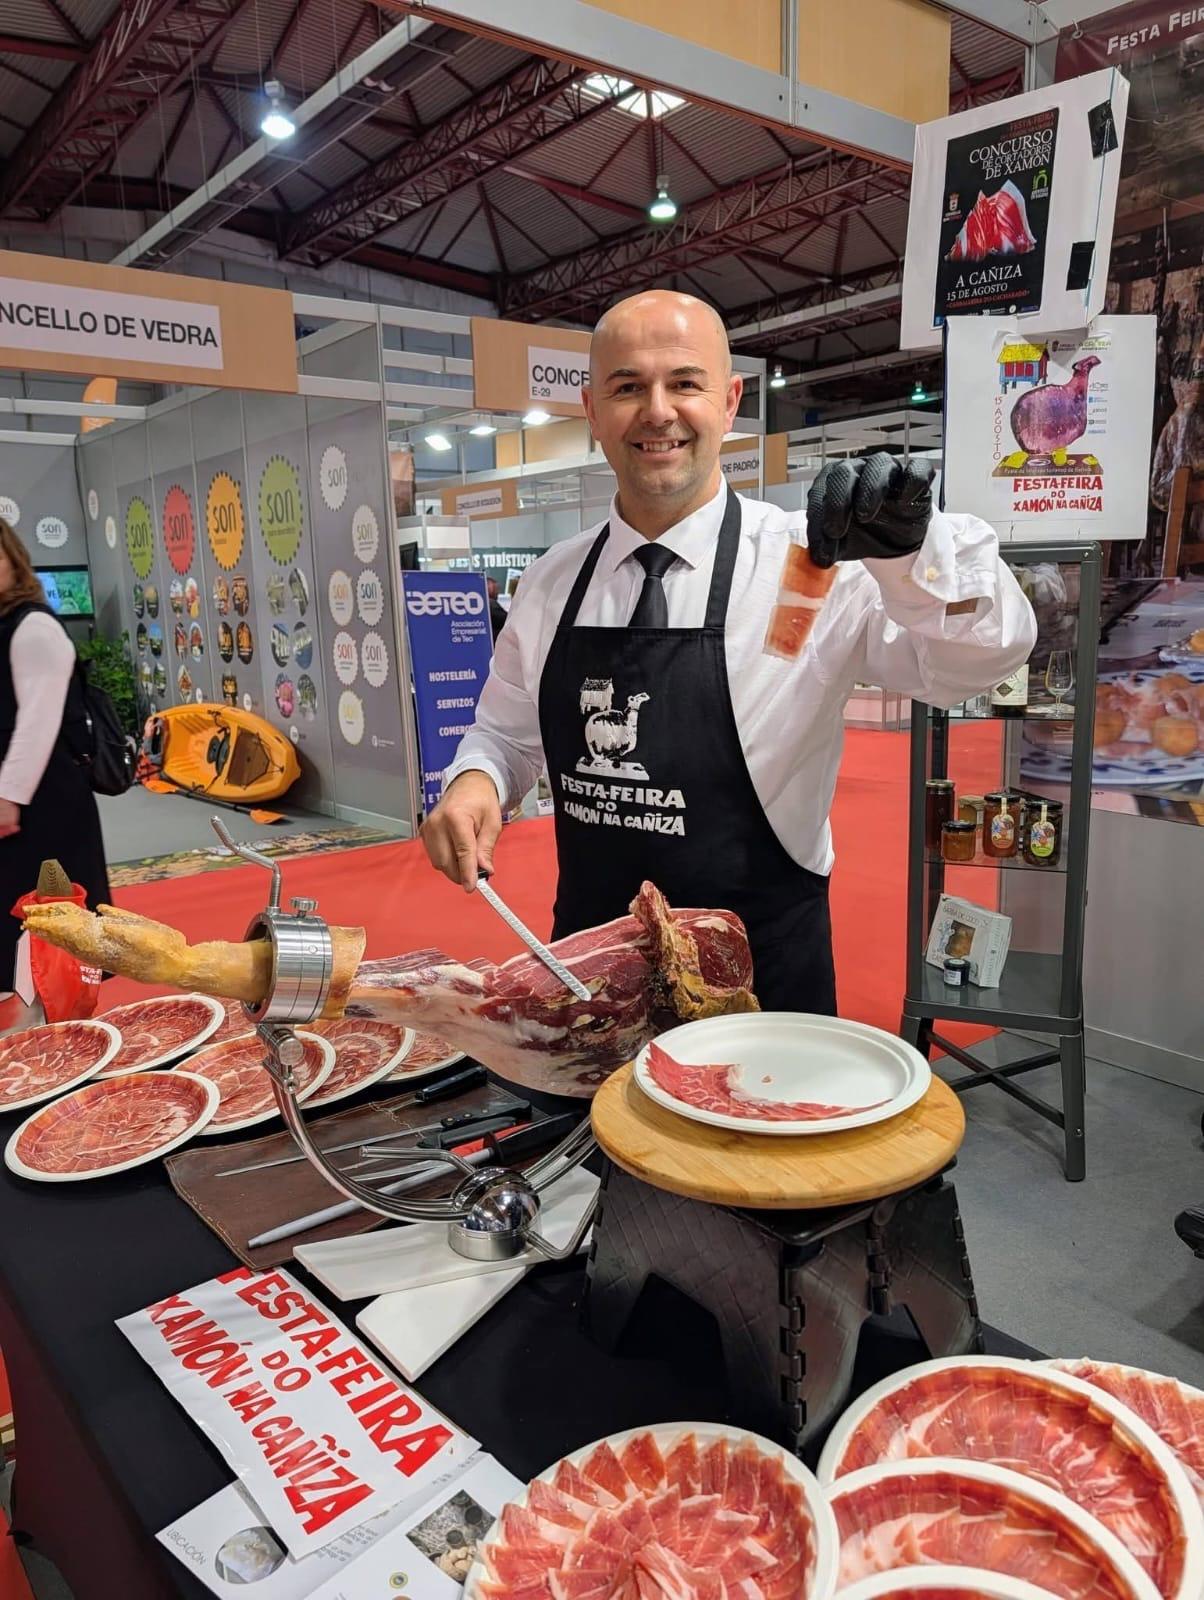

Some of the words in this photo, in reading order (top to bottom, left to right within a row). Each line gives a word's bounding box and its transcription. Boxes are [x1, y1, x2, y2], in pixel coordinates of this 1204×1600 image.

[1106, 24, 1160, 55] FESTA
[969, 128, 1053, 164] CONCURSO
[982, 159, 994, 170] DE
[995, 142, 1052, 166] CORTADORES
[985, 165, 1001, 180] DE
[955, 275, 965, 288] A
[969, 264, 1023, 286] CAÑIZA
[947, 291, 957, 302] 15
[958, 289, 970, 299] DE
[971, 282, 1008, 298] AGOSTO
[0, 302, 98, 333] NCELLO
[104, 314, 137, 338] DE
[141, 318, 218, 348] VEDRA
[531, 386, 551, 397] E-29
[722, 463, 732, 474] DE
[1013, 475, 1103, 493] FESTA-FEIRA
[1051, 490, 1066, 499] DO
[267, 488, 295, 525] son
[1013, 496, 1054, 513] XAMÓN
[1055, 499, 1068, 510] NA
[168, 513, 189, 541] son
[213, 502, 237, 533] son
[130, 522, 150, 548] son
[429, 668, 477, 682] HOSTELERÍA
[436, 697, 475, 709] SERVIZOS
[560, 773, 687, 808] FESTA-FEIRA
[596, 801, 617, 812] DO
[603, 812, 622, 826] NA
[145, 1295, 254, 1389] XAMÓN
[222, 1381, 278, 1425] NA
[261, 1350, 312, 1392] DO
